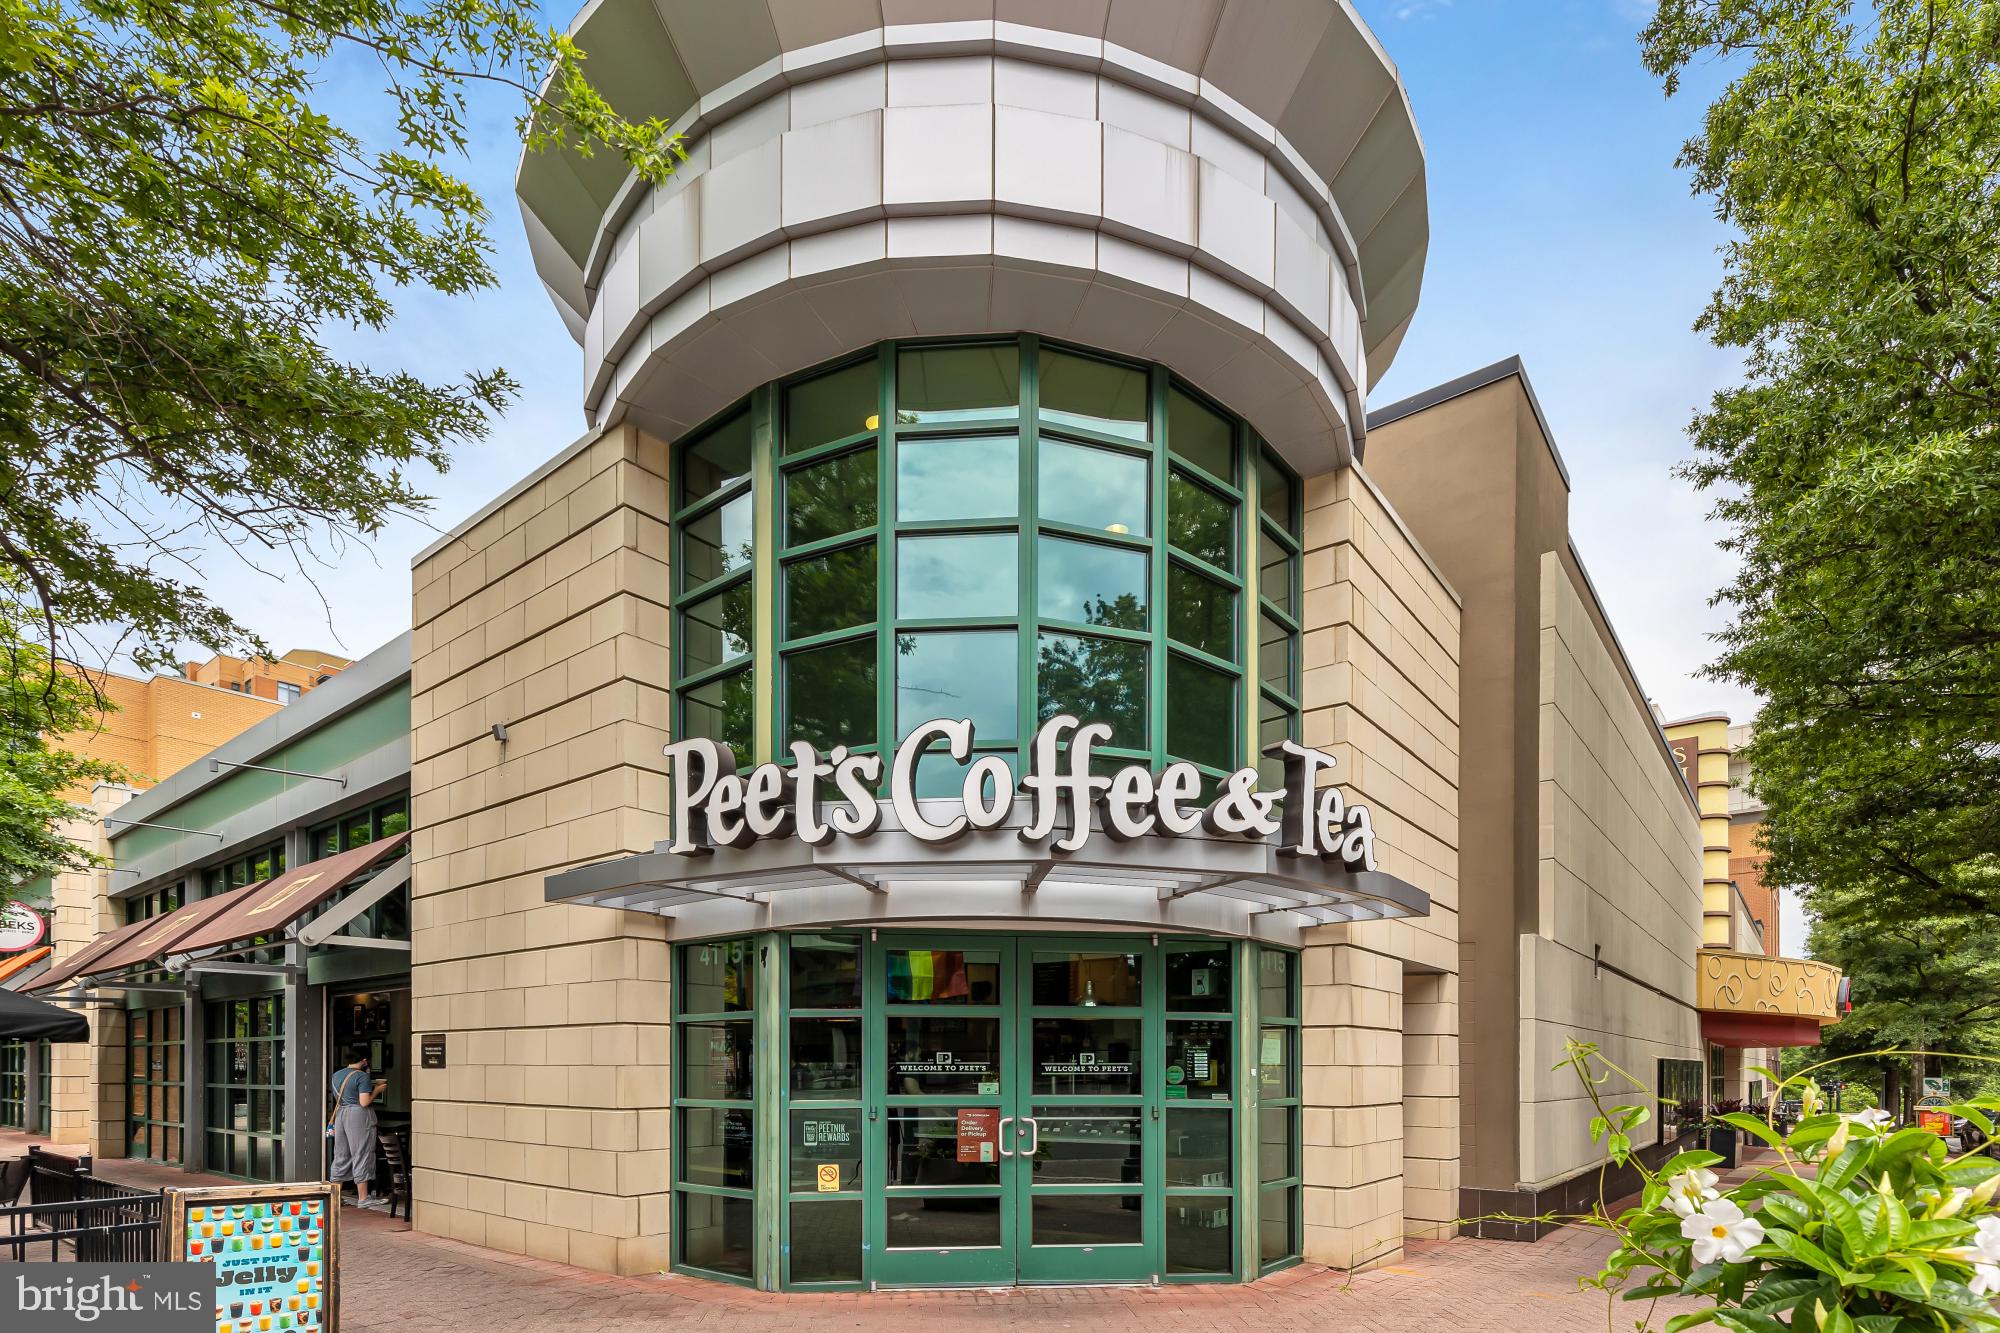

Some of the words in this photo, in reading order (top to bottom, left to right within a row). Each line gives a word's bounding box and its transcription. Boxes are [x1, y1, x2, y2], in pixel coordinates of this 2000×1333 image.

[664, 737, 884, 855] Peet's
[891, 715, 1201, 851] Coffee
[1210, 767, 1288, 837] &
[1263, 740, 1379, 872] Tea
[700, 942, 742, 966] 4115
[818, 1123, 846, 1132] PEETNIK
[818, 1133, 850, 1142] REWARDS
[222, 1257, 260, 1267] JUST
[262, 1254, 290, 1264] PUT
[216, 1265, 298, 1287] Jelly
[239, 1287, 256, 1296] IN
[258, 1286, 273, 1294] IT
